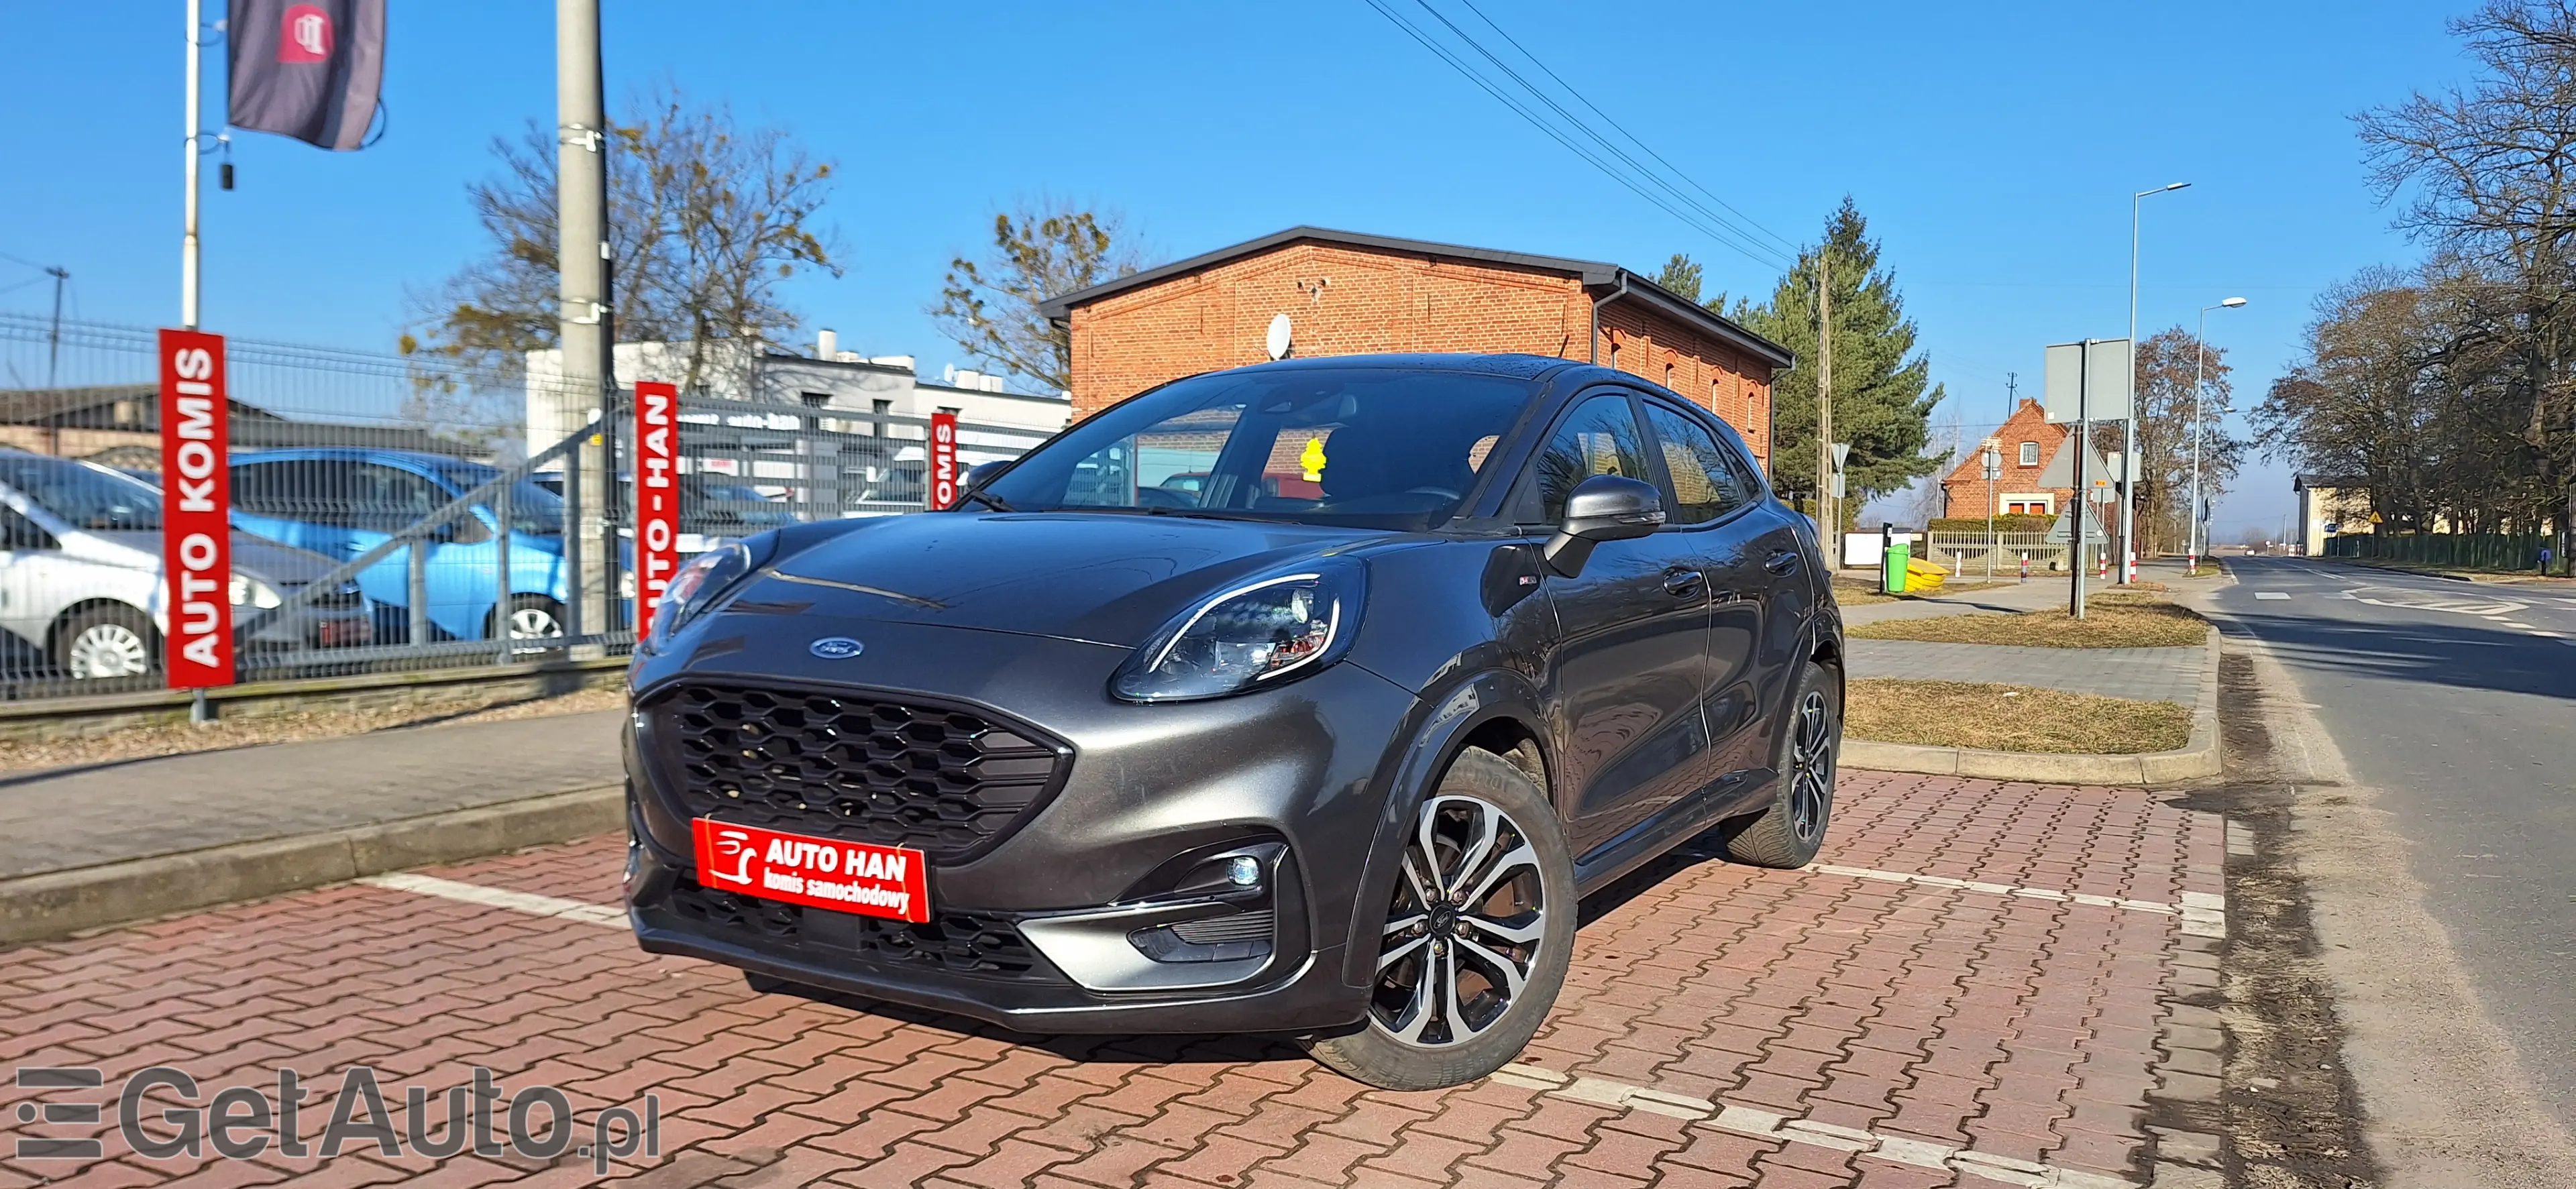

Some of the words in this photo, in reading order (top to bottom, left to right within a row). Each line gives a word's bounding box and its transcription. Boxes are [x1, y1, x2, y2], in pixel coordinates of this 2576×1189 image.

[174, 347, 215, 512] KOMIS
[180, 533, 219, 668] AUTO
[763, 867, 804, 895] komis
[806, 878, 910, 915] samochodowy
[765, 838, 838, 872] AUTO
[845, 849, 906, 882] HAN
